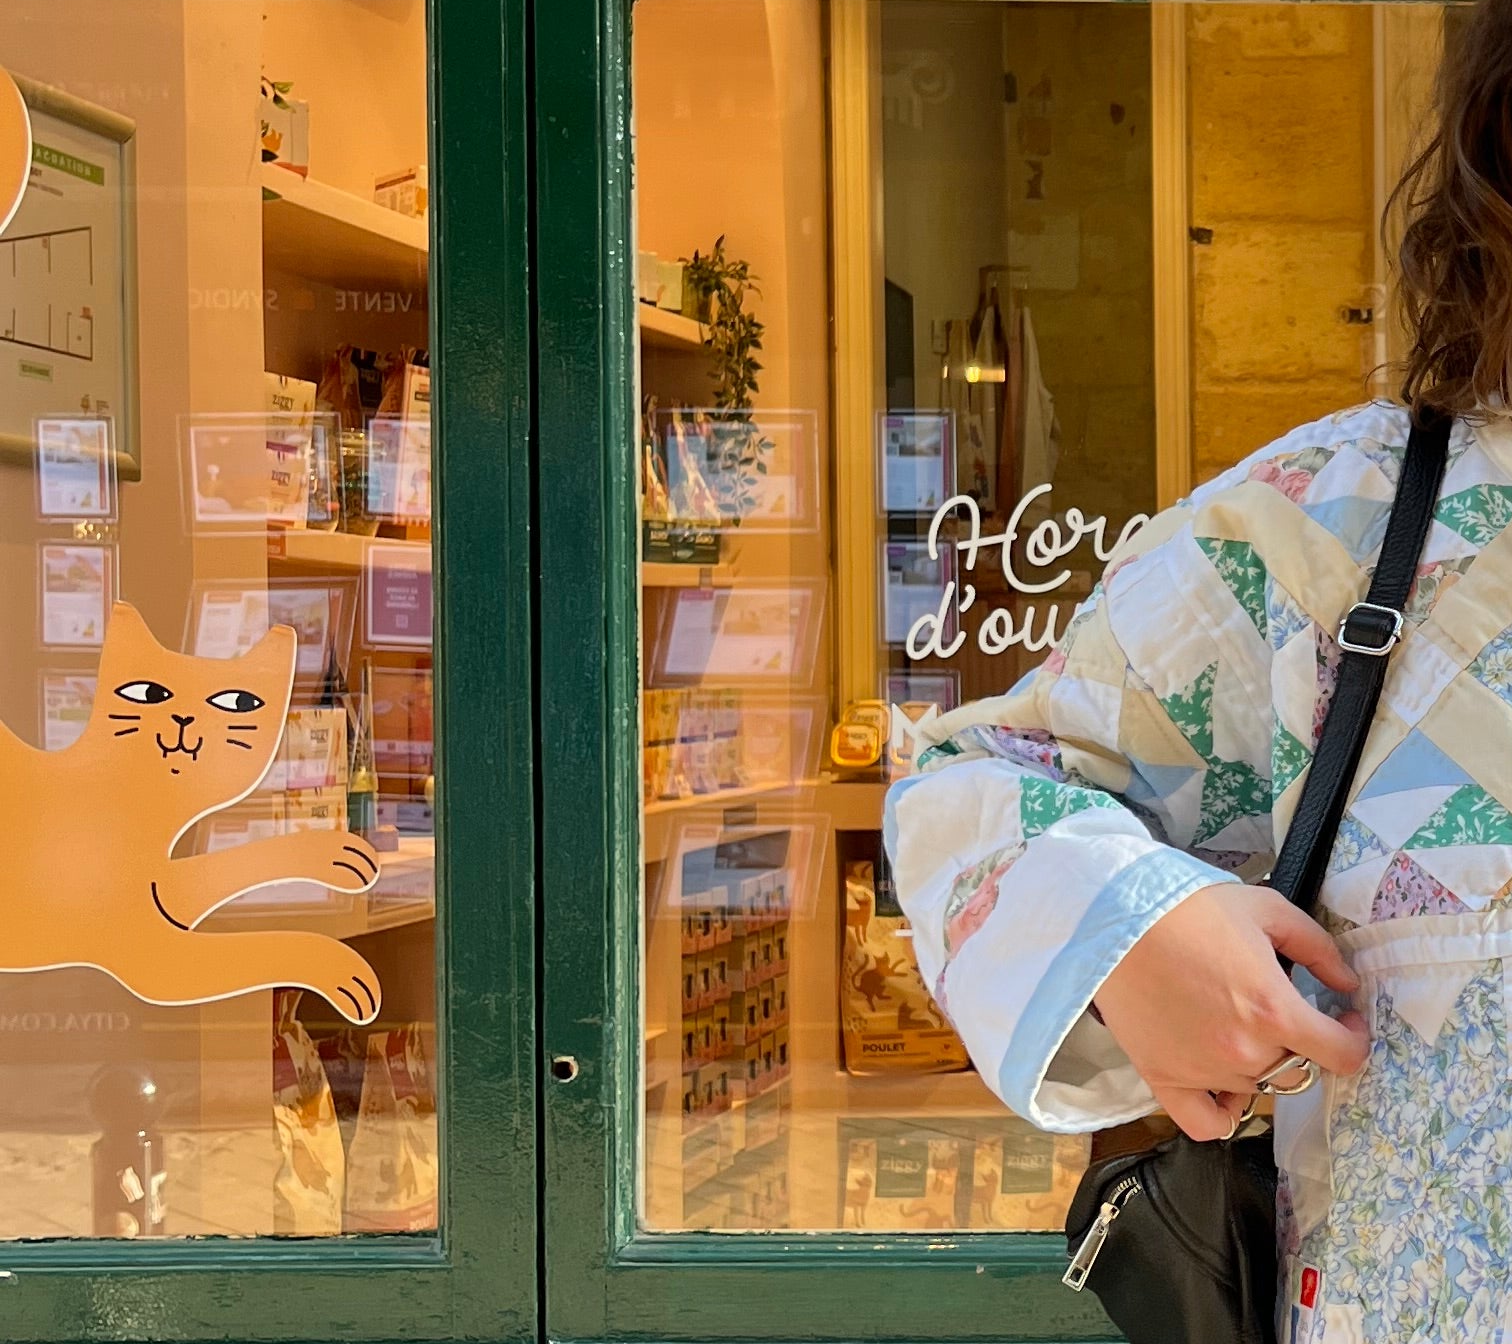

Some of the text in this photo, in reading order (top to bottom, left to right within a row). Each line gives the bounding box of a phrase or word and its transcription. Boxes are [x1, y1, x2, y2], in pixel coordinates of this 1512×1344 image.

[905, 581, 1063, 660] d'ou
[862, 1042, 906, 1053] POULET
[879, 1158, 924, 1174] ziggy
